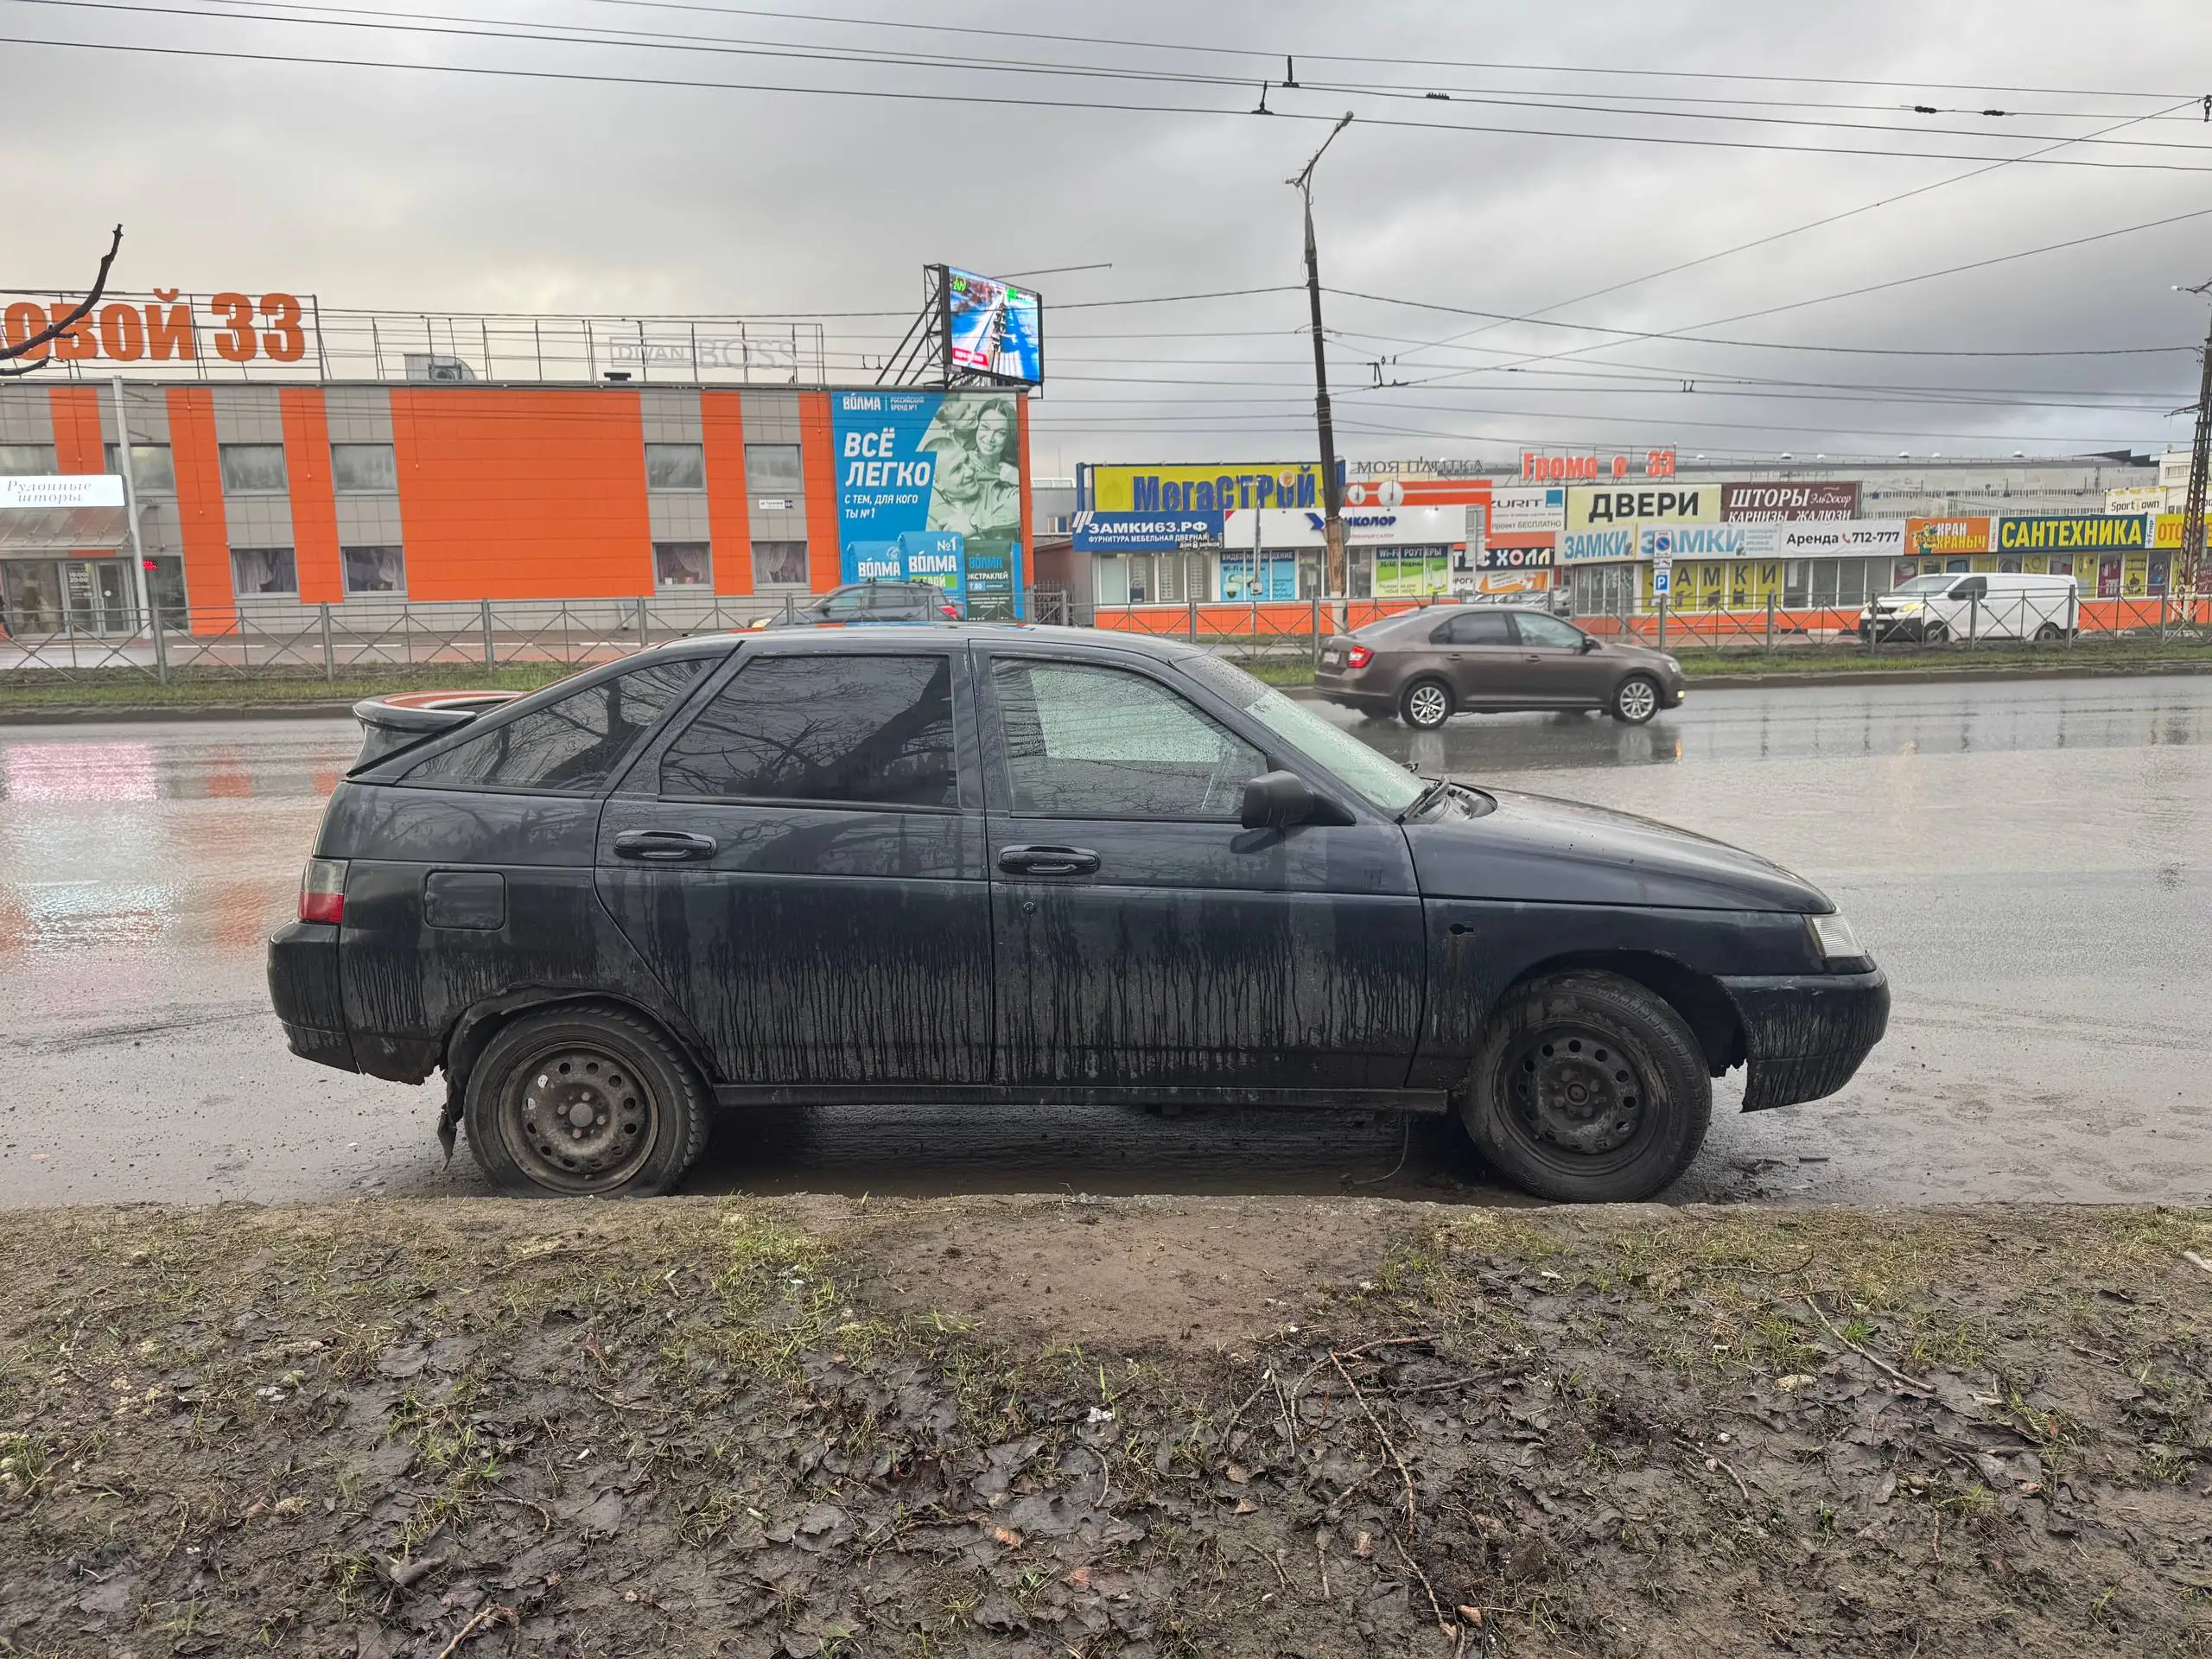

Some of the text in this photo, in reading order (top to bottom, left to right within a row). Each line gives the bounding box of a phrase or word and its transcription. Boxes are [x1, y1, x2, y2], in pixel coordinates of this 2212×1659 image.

[212, 292, 305, 361] 33
[618, 338, 797, 370] DIVAN BOSS
[844, 427, 895, 457] ВСЁ
[1357, 461, 1400, 474] МОЯ
[1646, 449, 1675, 477] 33
[845, 461, 931, 486] ЛЕГКО
[7, 480, 92, 493] Рулонные
[18, 493, 83, 505] шторы
[845, 494, 918, 505] С ТЕМ, ДЛЯ КОГО
[1730, 488, 1810, 508] ШТОРЫ
[846, 509, 858, 518] ТЫ
[1588, 493, 1699, 523] ДВЕРИ
[1517, 520, 1561, 529] БЕСПЛАТНО
[1728, 511, 1789, 523] КАРНИЗЫ
[1088, 521, 1208, 534] ЗАМКИ63.РФ
[1936, 522, 1967, 537] КРАН
[2002, 518, 2142, 549] САНТЕХНИКА
[1564, 531, 1630, 560] ЗАМКИ
[1786, 533, 1839, 547] Аренда
[1852, 531, 1899, 543] 712-777
[1937, 535, 1986, 549] КРАНЫЧ
